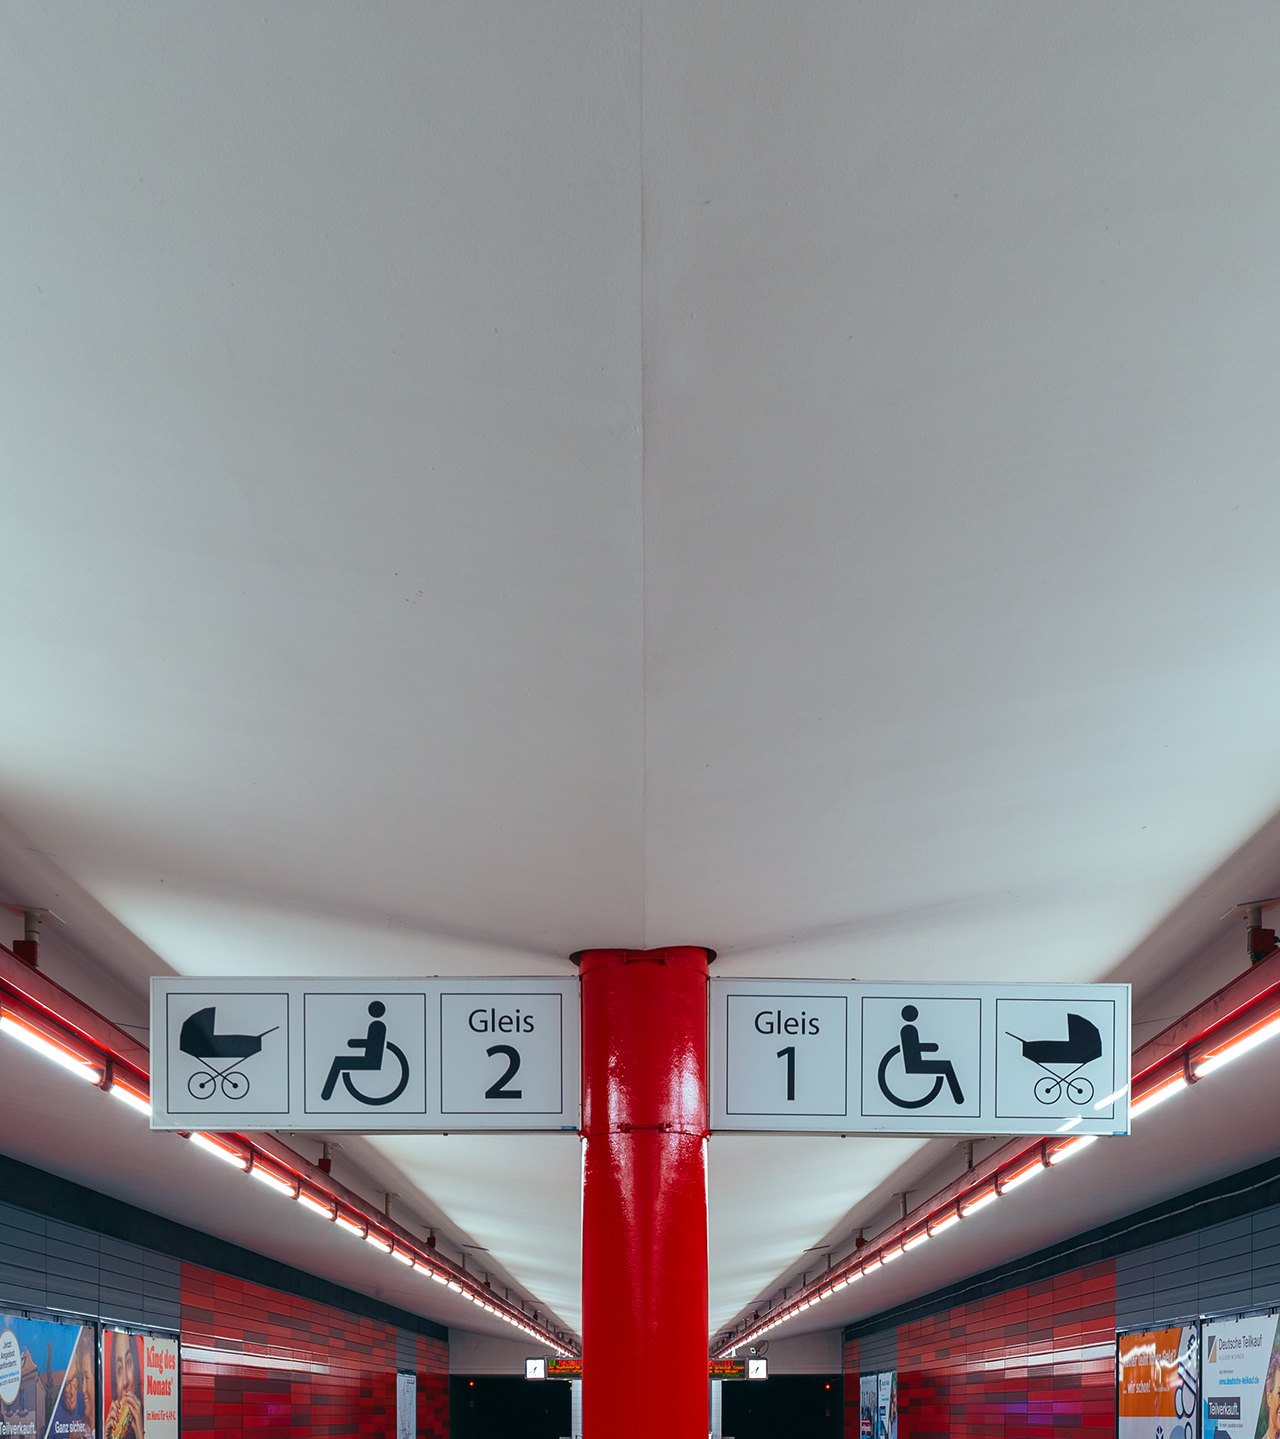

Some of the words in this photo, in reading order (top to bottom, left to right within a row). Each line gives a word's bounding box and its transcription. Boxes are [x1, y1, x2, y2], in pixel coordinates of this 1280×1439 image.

[468, 1008, 534, 1033] Gleis
[754, 1010, 820, 1035] Gleis
[485, 1044, 522, 1099] 2
[776, 1046, 795, 1101] 1
[1218, 1336, 1241, 1351] Deutsche
[1242, 1333, 1262, 1348] Teilkauf
[146, 1345, 164, 1374] King
[164, 1349, 175, 1370] des
[1208, 1401, 1240, 1416] Teilverkauft.
[55, 1420, 69, 1433] Ganz
